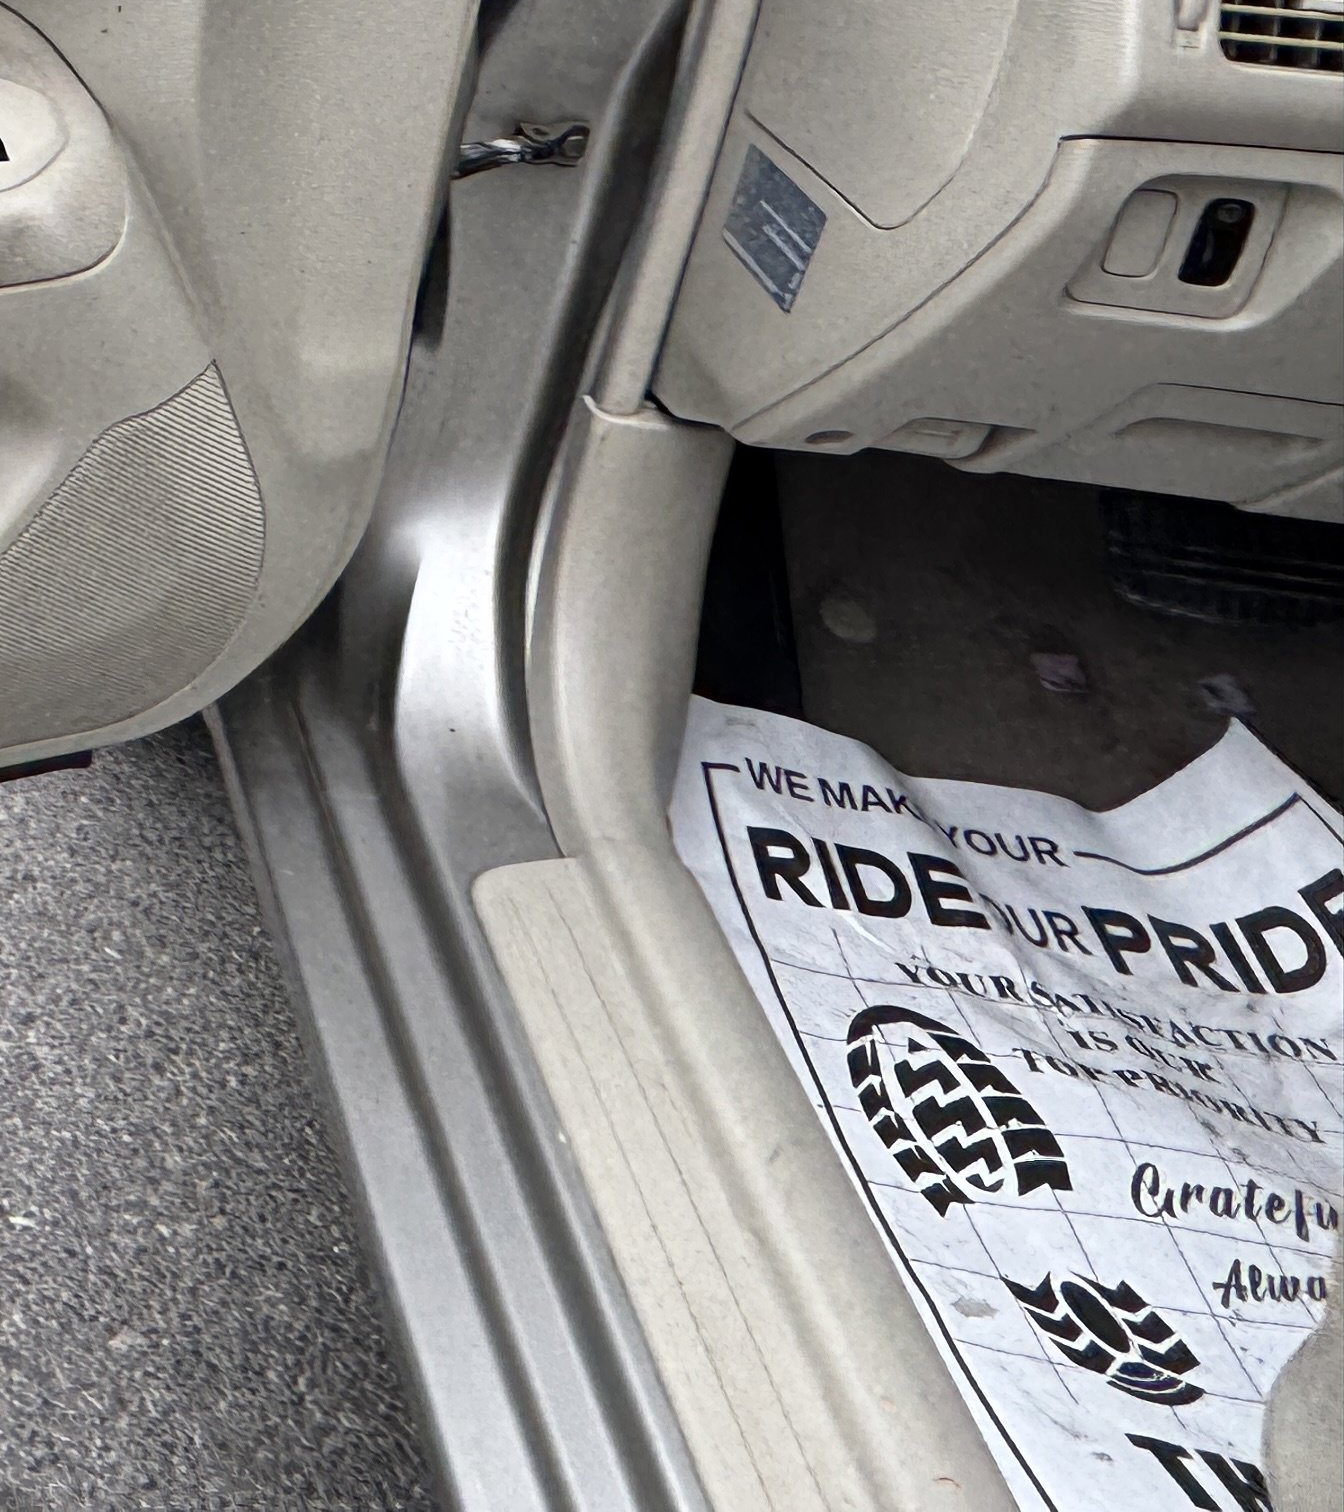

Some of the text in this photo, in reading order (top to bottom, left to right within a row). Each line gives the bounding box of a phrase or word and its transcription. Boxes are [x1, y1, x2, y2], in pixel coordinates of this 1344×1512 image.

[745, 756, 1070, 868] WE MAK YOUR
[746, 825, 991, 929] RIDE
[894, 961, 1025, 1003] YOUR
[1066, 1030, 1222, 1085] IS OUR
[1112, 1068, 1327, 1145] PRIORITY
[1130, 1162, 1339, 1243] Gratefu
[1211, 1258, 1328, 1310] Alwa
